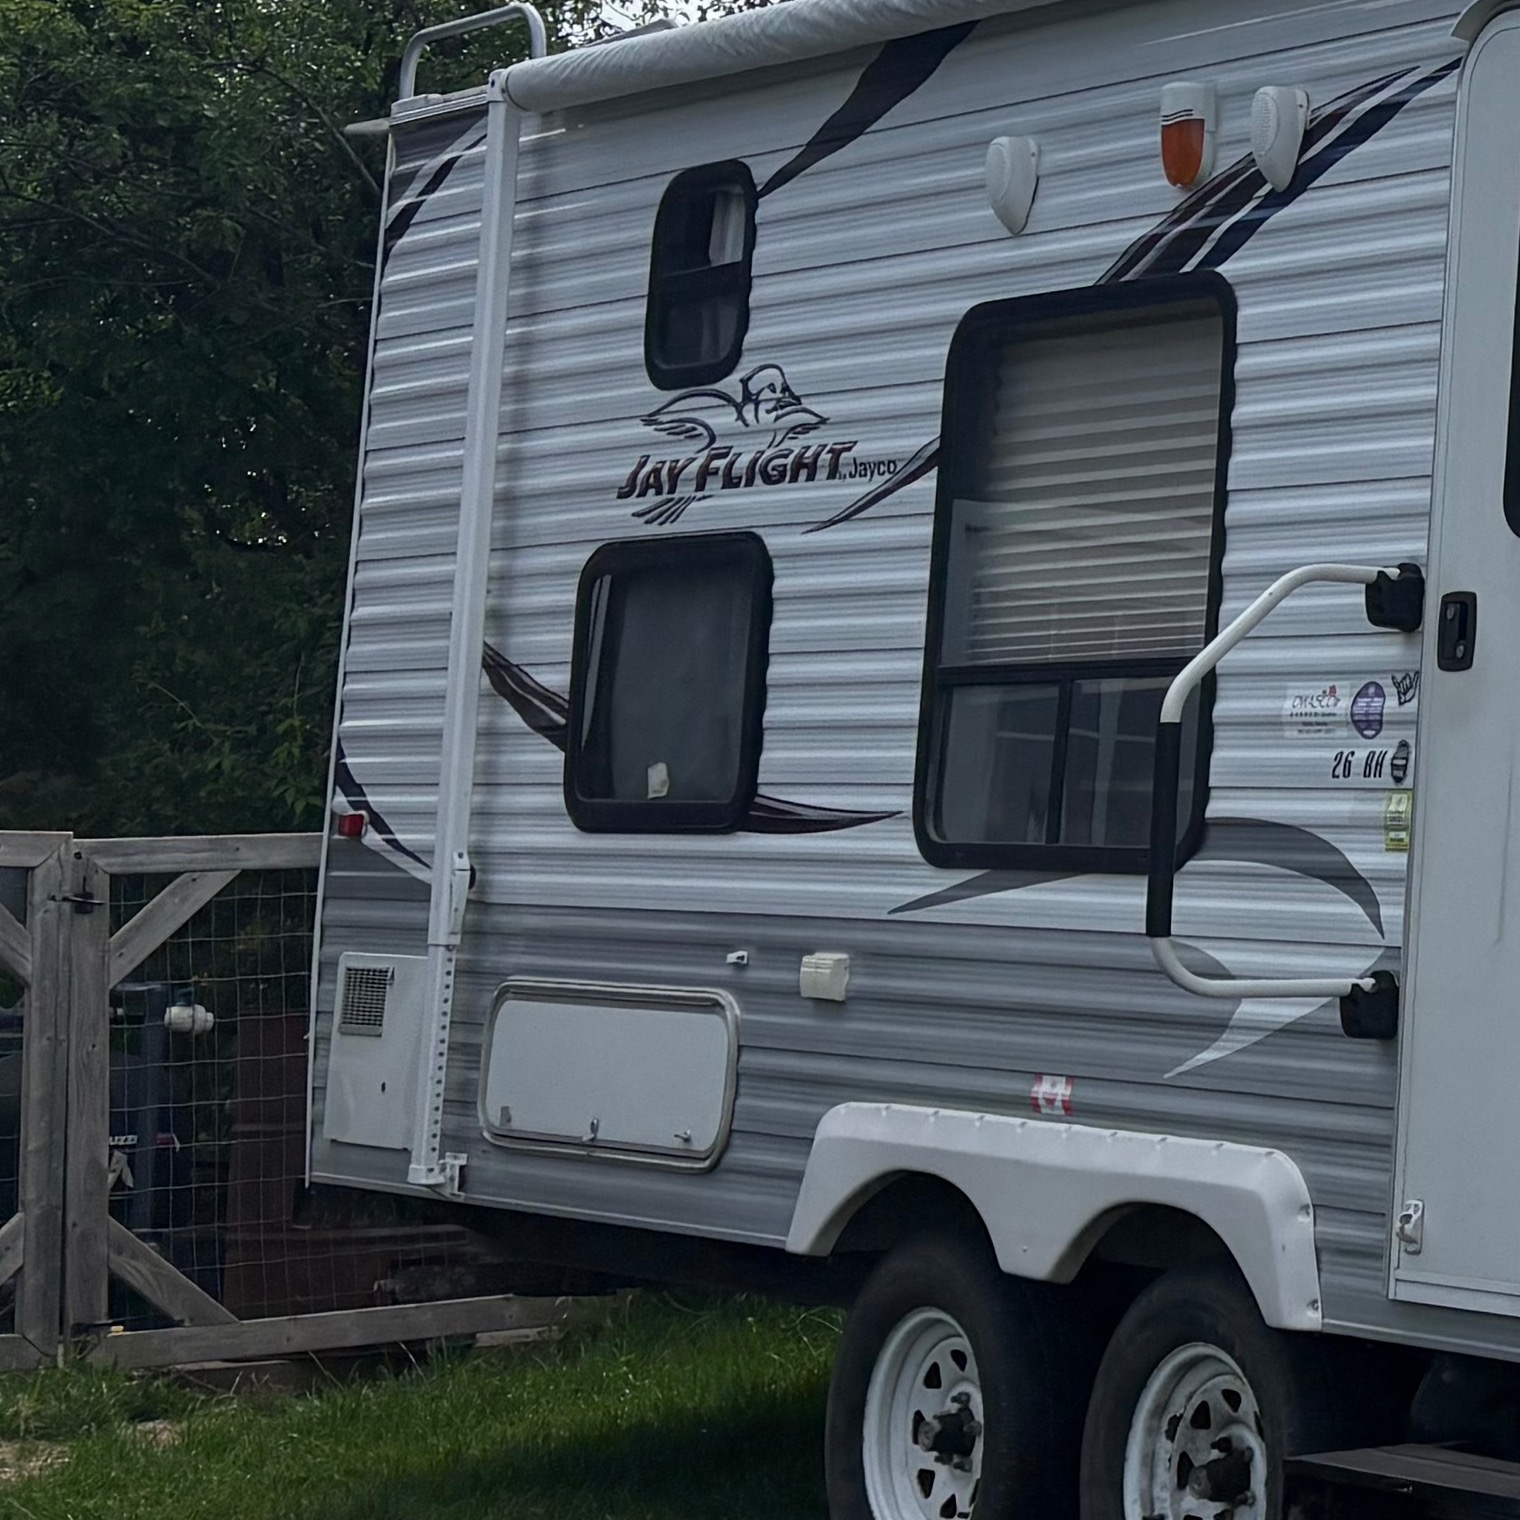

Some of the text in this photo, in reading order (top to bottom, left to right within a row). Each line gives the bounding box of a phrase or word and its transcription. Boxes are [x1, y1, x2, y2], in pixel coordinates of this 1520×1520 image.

[616, 440, 898, 499] JAY FLIGHT Jayco
[1331, 750, 1356, 779] 26
[1363, 750, 1389, 779] BH
